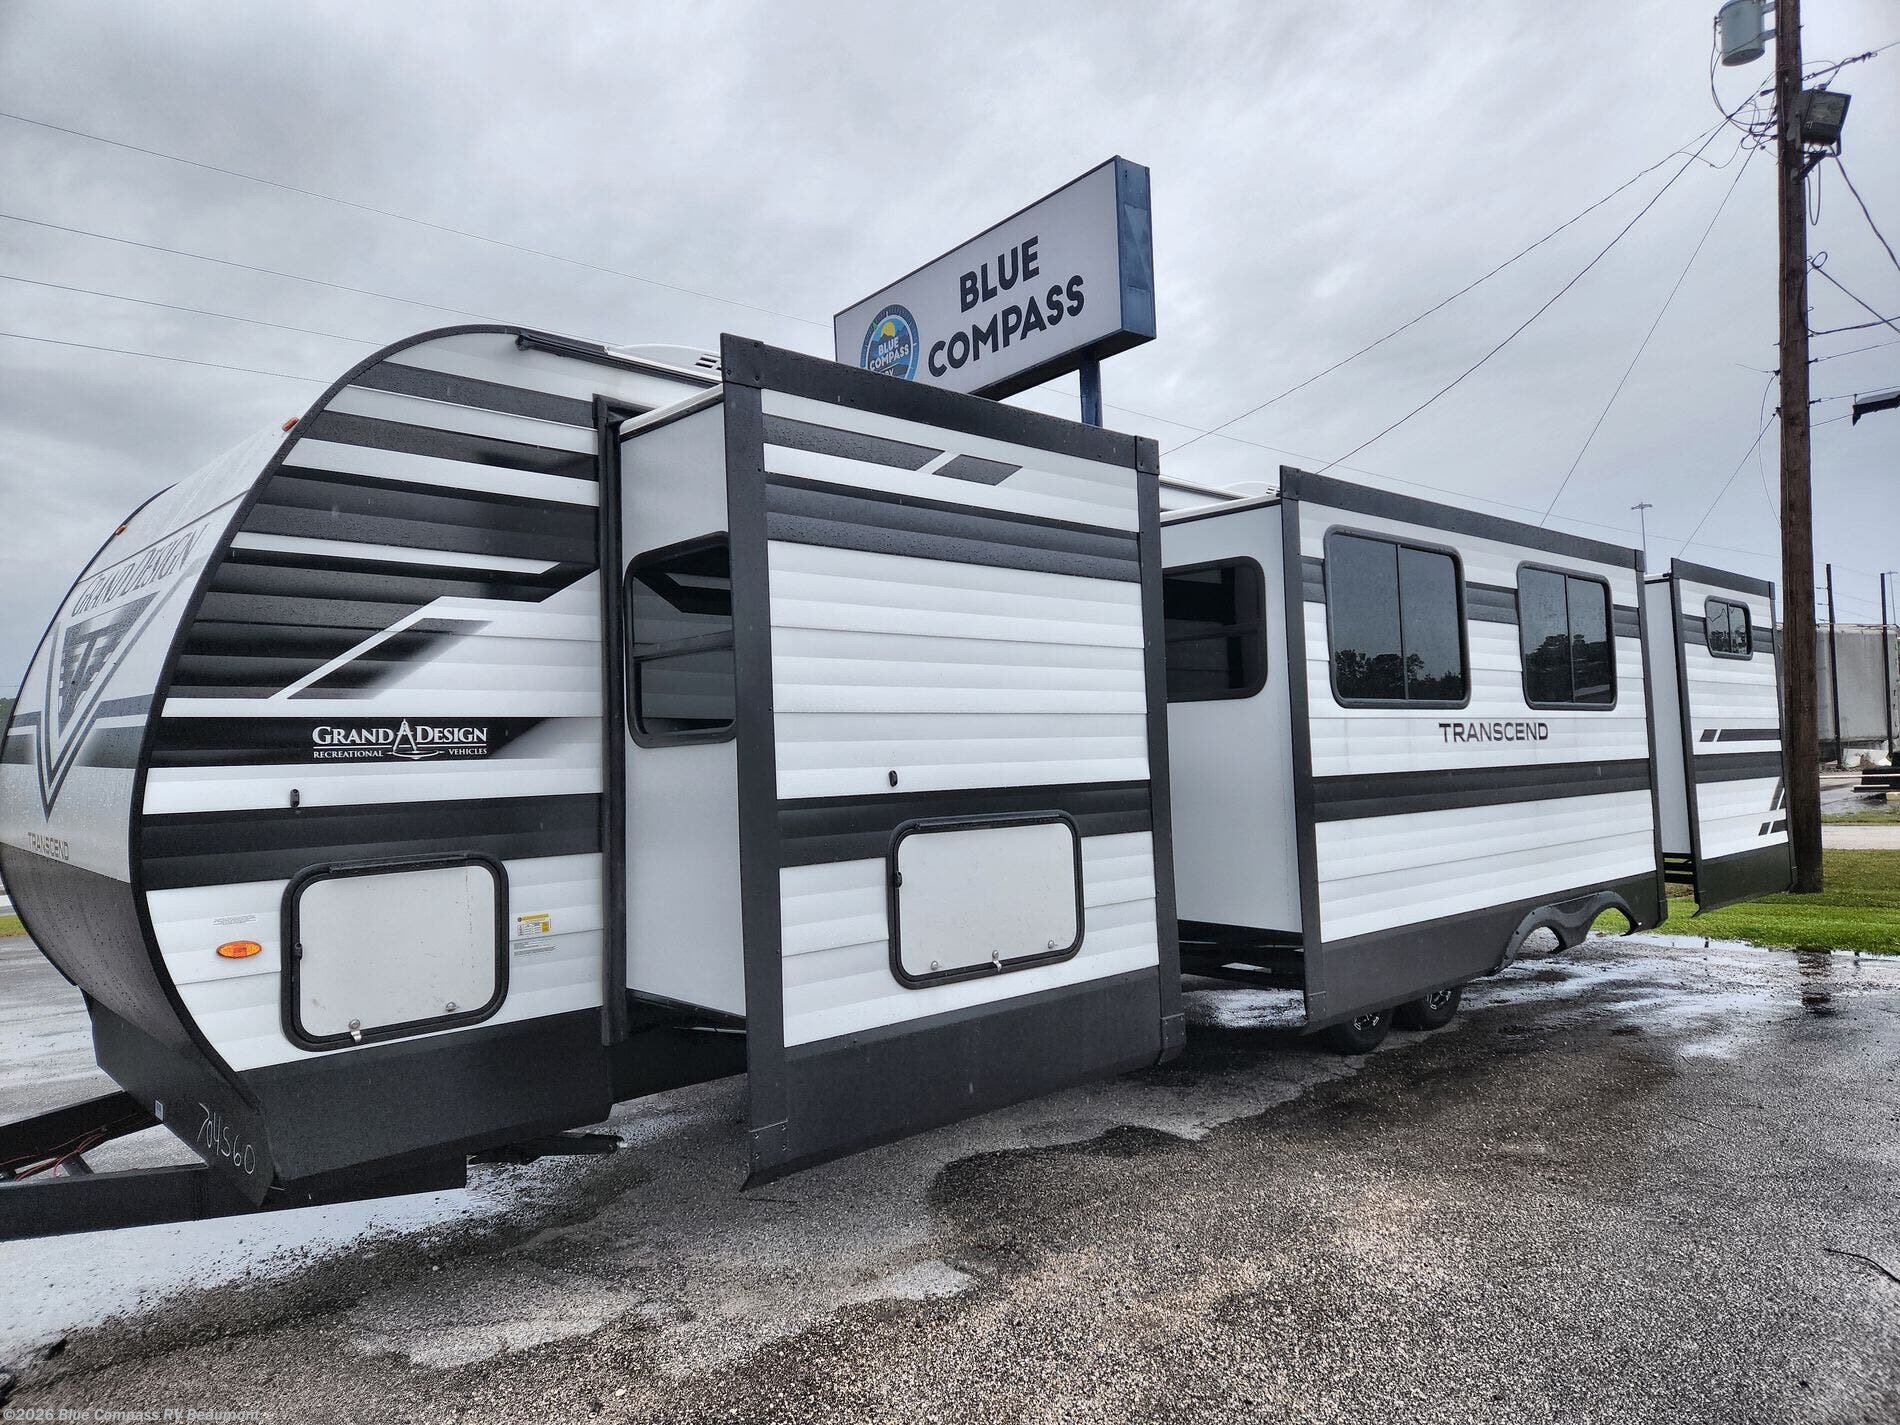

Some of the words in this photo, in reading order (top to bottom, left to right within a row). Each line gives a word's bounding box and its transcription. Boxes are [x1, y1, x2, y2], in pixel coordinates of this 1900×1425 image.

[959, 235, 1041, 314] BLUE
[927, 274, 1086, 378] COMPASS
[869, 344, 910, 371] COMPASS
[878, 336, 900, 357] BLUE
[71, 562, 137, 618] GRAND
[131, 522, 211, 592] DESIGN
[312, 726, 394, 745] GRAND
[415, 725, 488, 743] DESIGN
[1438, 722, 1549, 743] TRANSCEND
[313, 750, 384, 759] RECREATIONAL
[448, 748, 488, 756] VEHICLES
[27, 831, 70, 861] TRANSCEND
